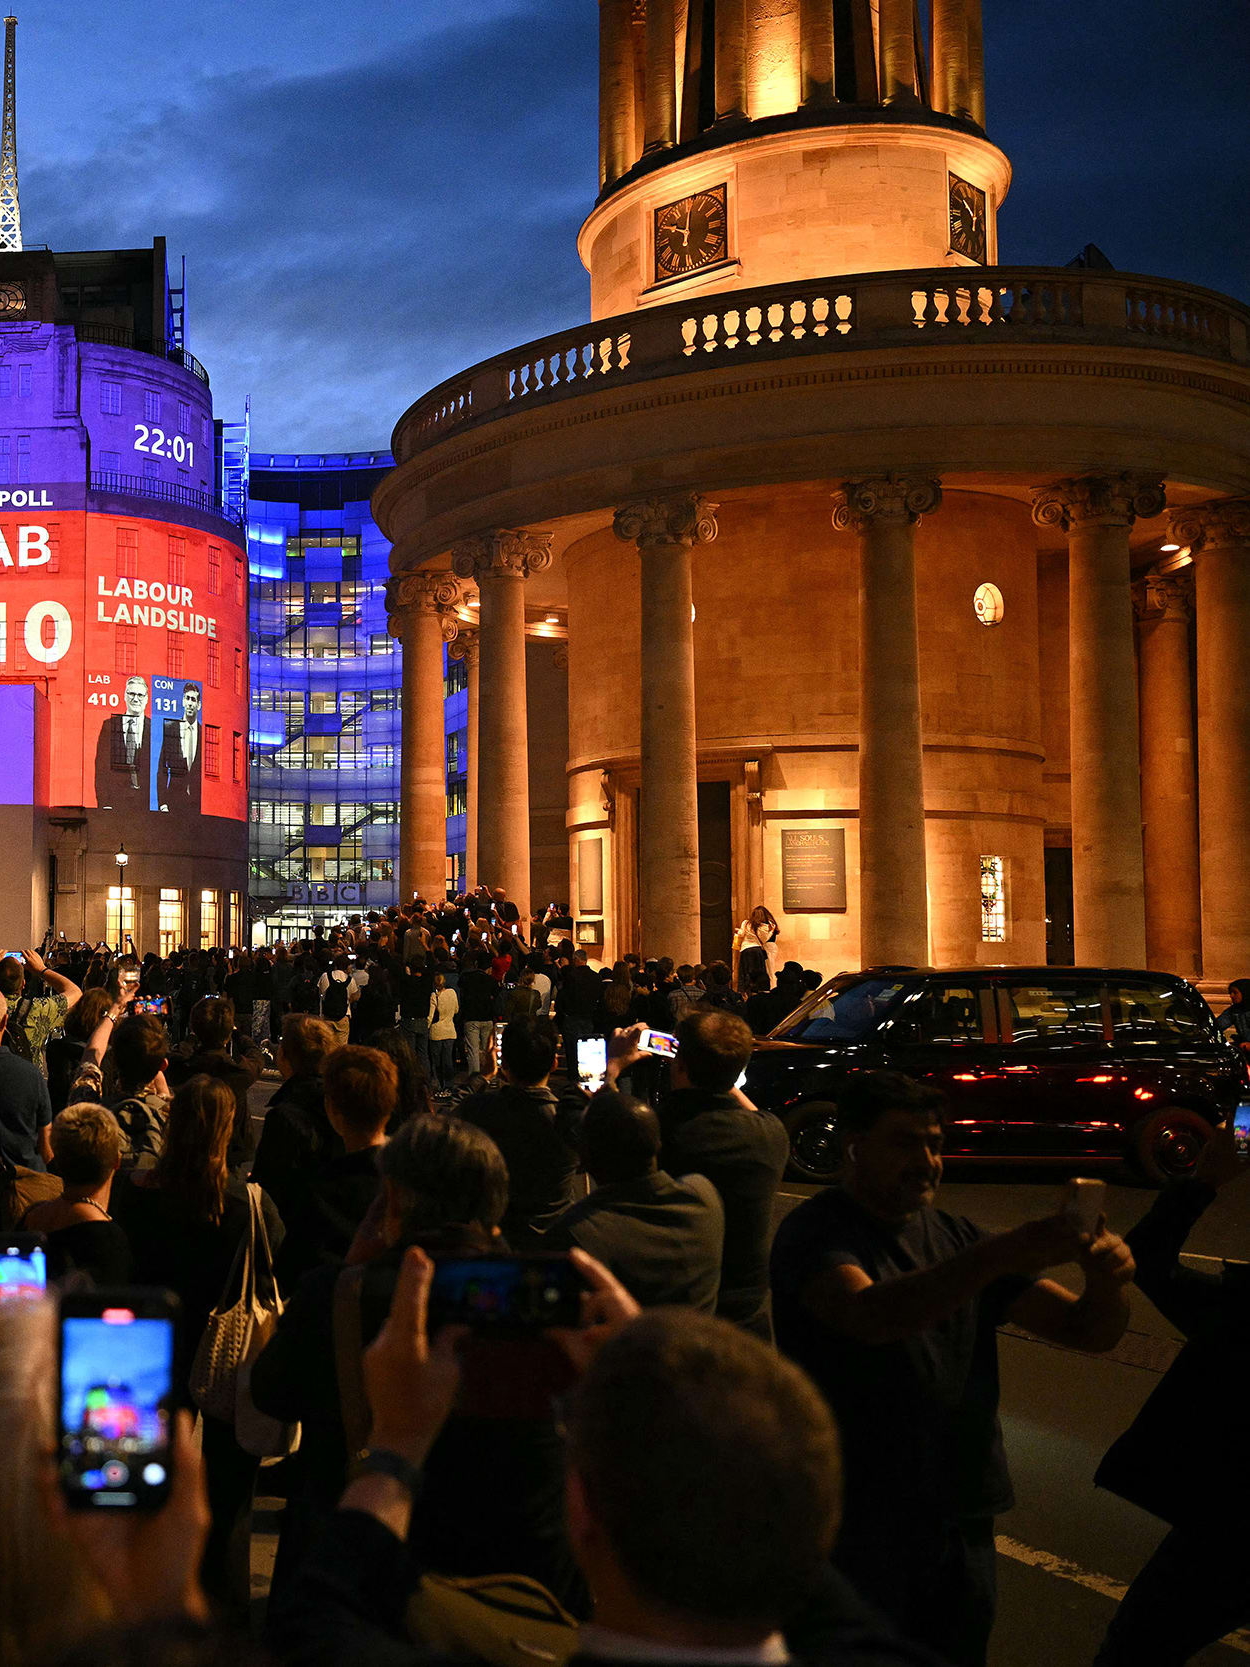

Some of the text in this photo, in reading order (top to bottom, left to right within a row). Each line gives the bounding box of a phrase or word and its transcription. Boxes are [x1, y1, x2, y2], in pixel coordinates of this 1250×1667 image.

[133, 424, 194, 468] 22:01
[97, 575, 194, 608] LABOUR
[97, 601, 217, 639] LANDSLIDE
[87, 674, 111, 685] LAB
[154, 679, 174, 691] CON
[87, 692, 119, 707] 410
[154, 697, 177, 713] 131
[292, 884, 357, 903] BBC
